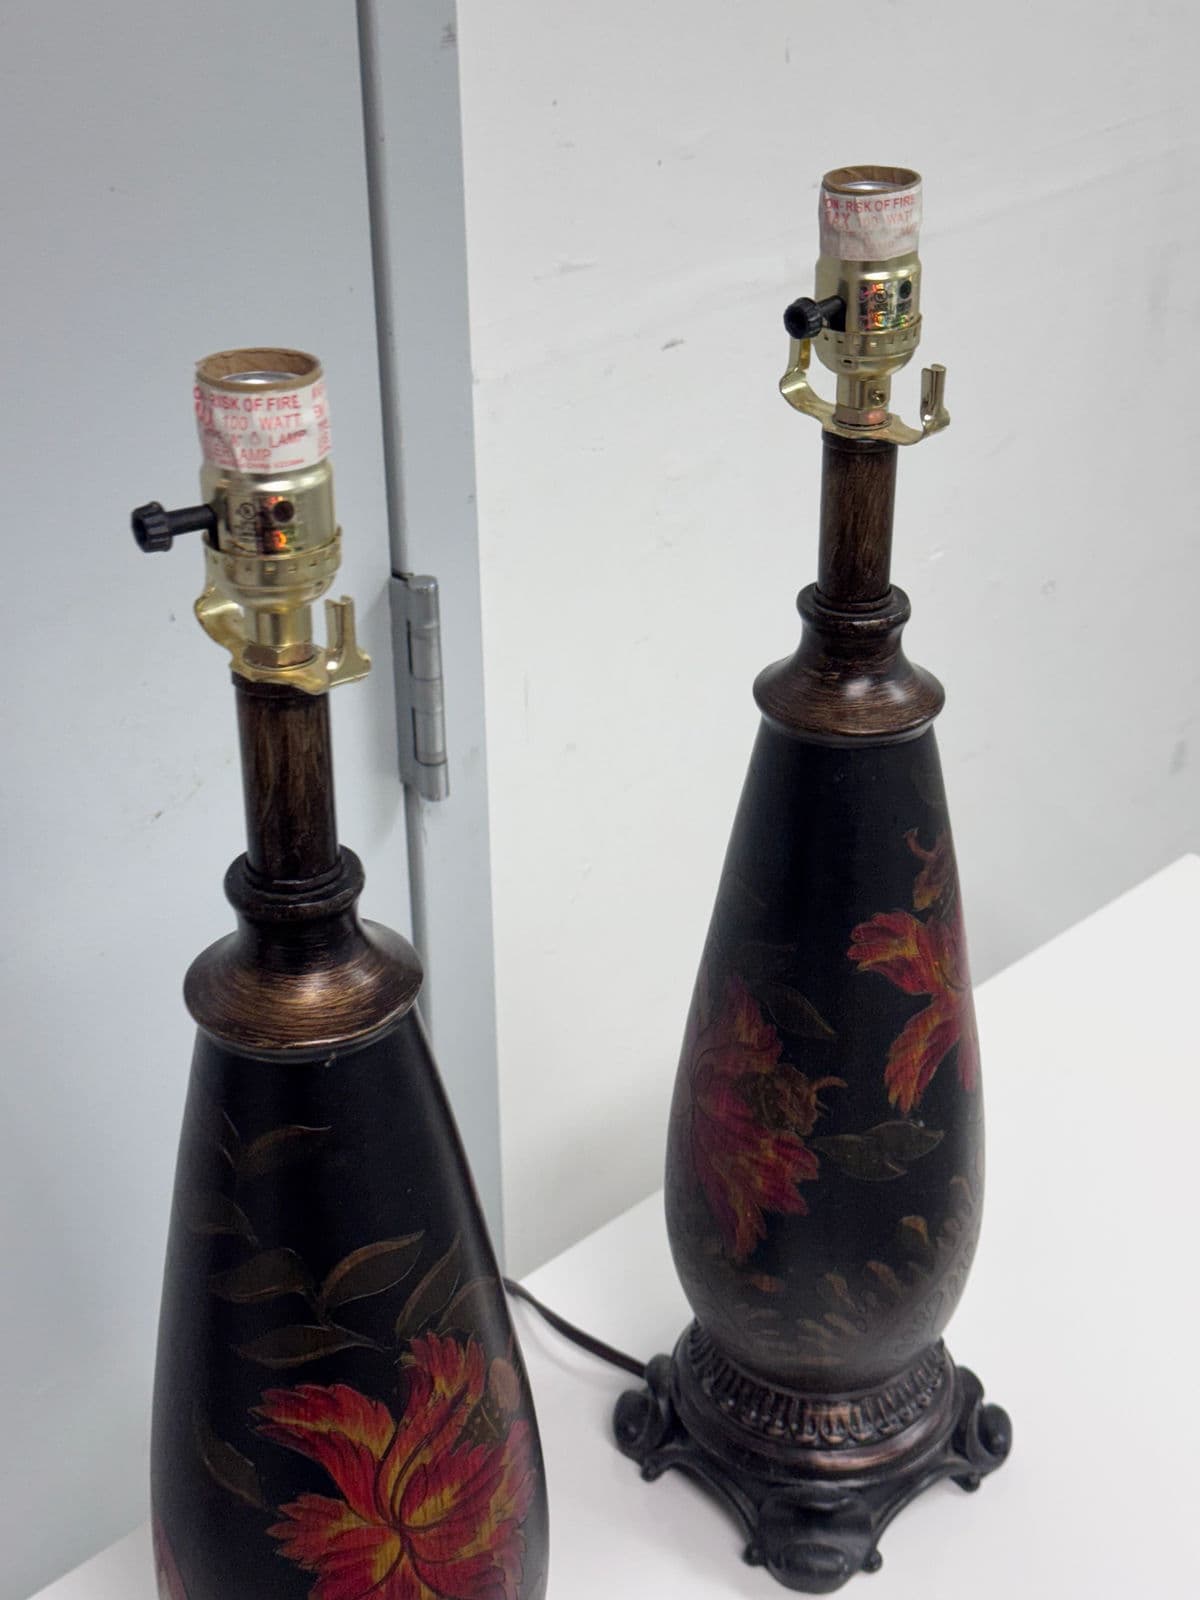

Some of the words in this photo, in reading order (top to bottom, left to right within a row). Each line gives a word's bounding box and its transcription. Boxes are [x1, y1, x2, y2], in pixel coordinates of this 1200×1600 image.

[845, 200, 871, 213] RISK
[874, 199, 891, 212] OF
[892, 194, 915, 209] FIRE
[209, 394, 240, 410] RISK
[242, 397, 262, 413] OF
[265, 394, 301, 410] FIRE
[223, 415, 249, 431] 100
[258, 412, 301, 431] WATT
[268, 429, 307, 448] LAMP
